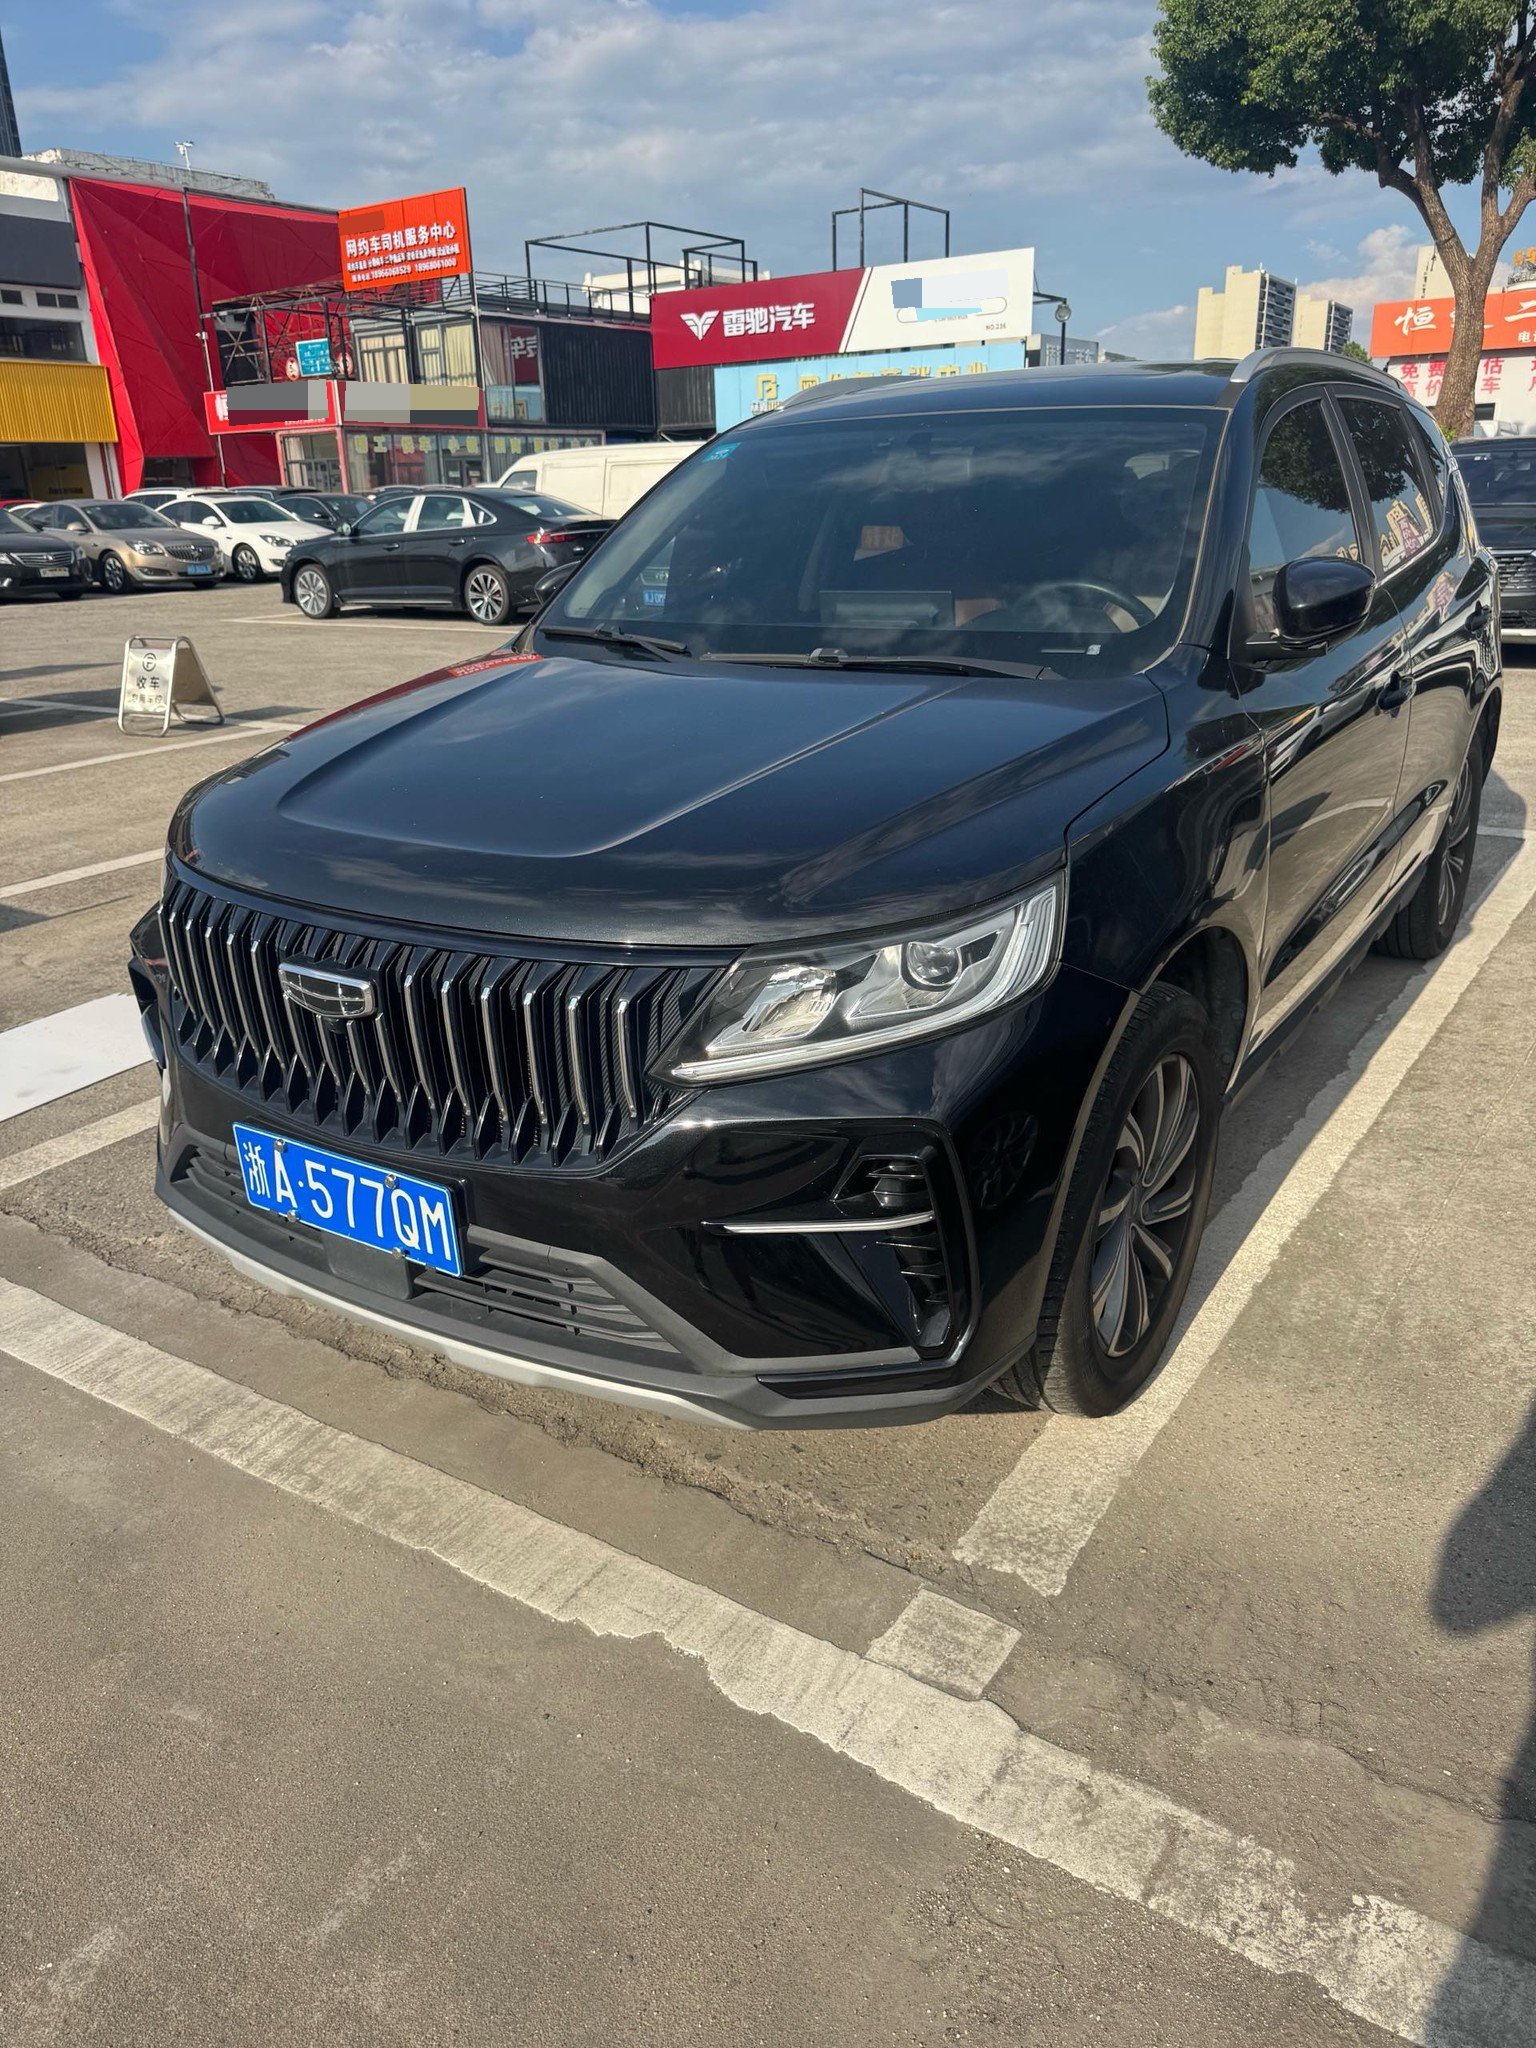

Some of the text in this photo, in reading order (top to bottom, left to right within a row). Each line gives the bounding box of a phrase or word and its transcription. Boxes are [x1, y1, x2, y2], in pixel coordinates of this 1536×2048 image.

[345, 220, 456, 258] 网约车司机服务中心
[722, 302, 815, 337] 雷驰汽车
